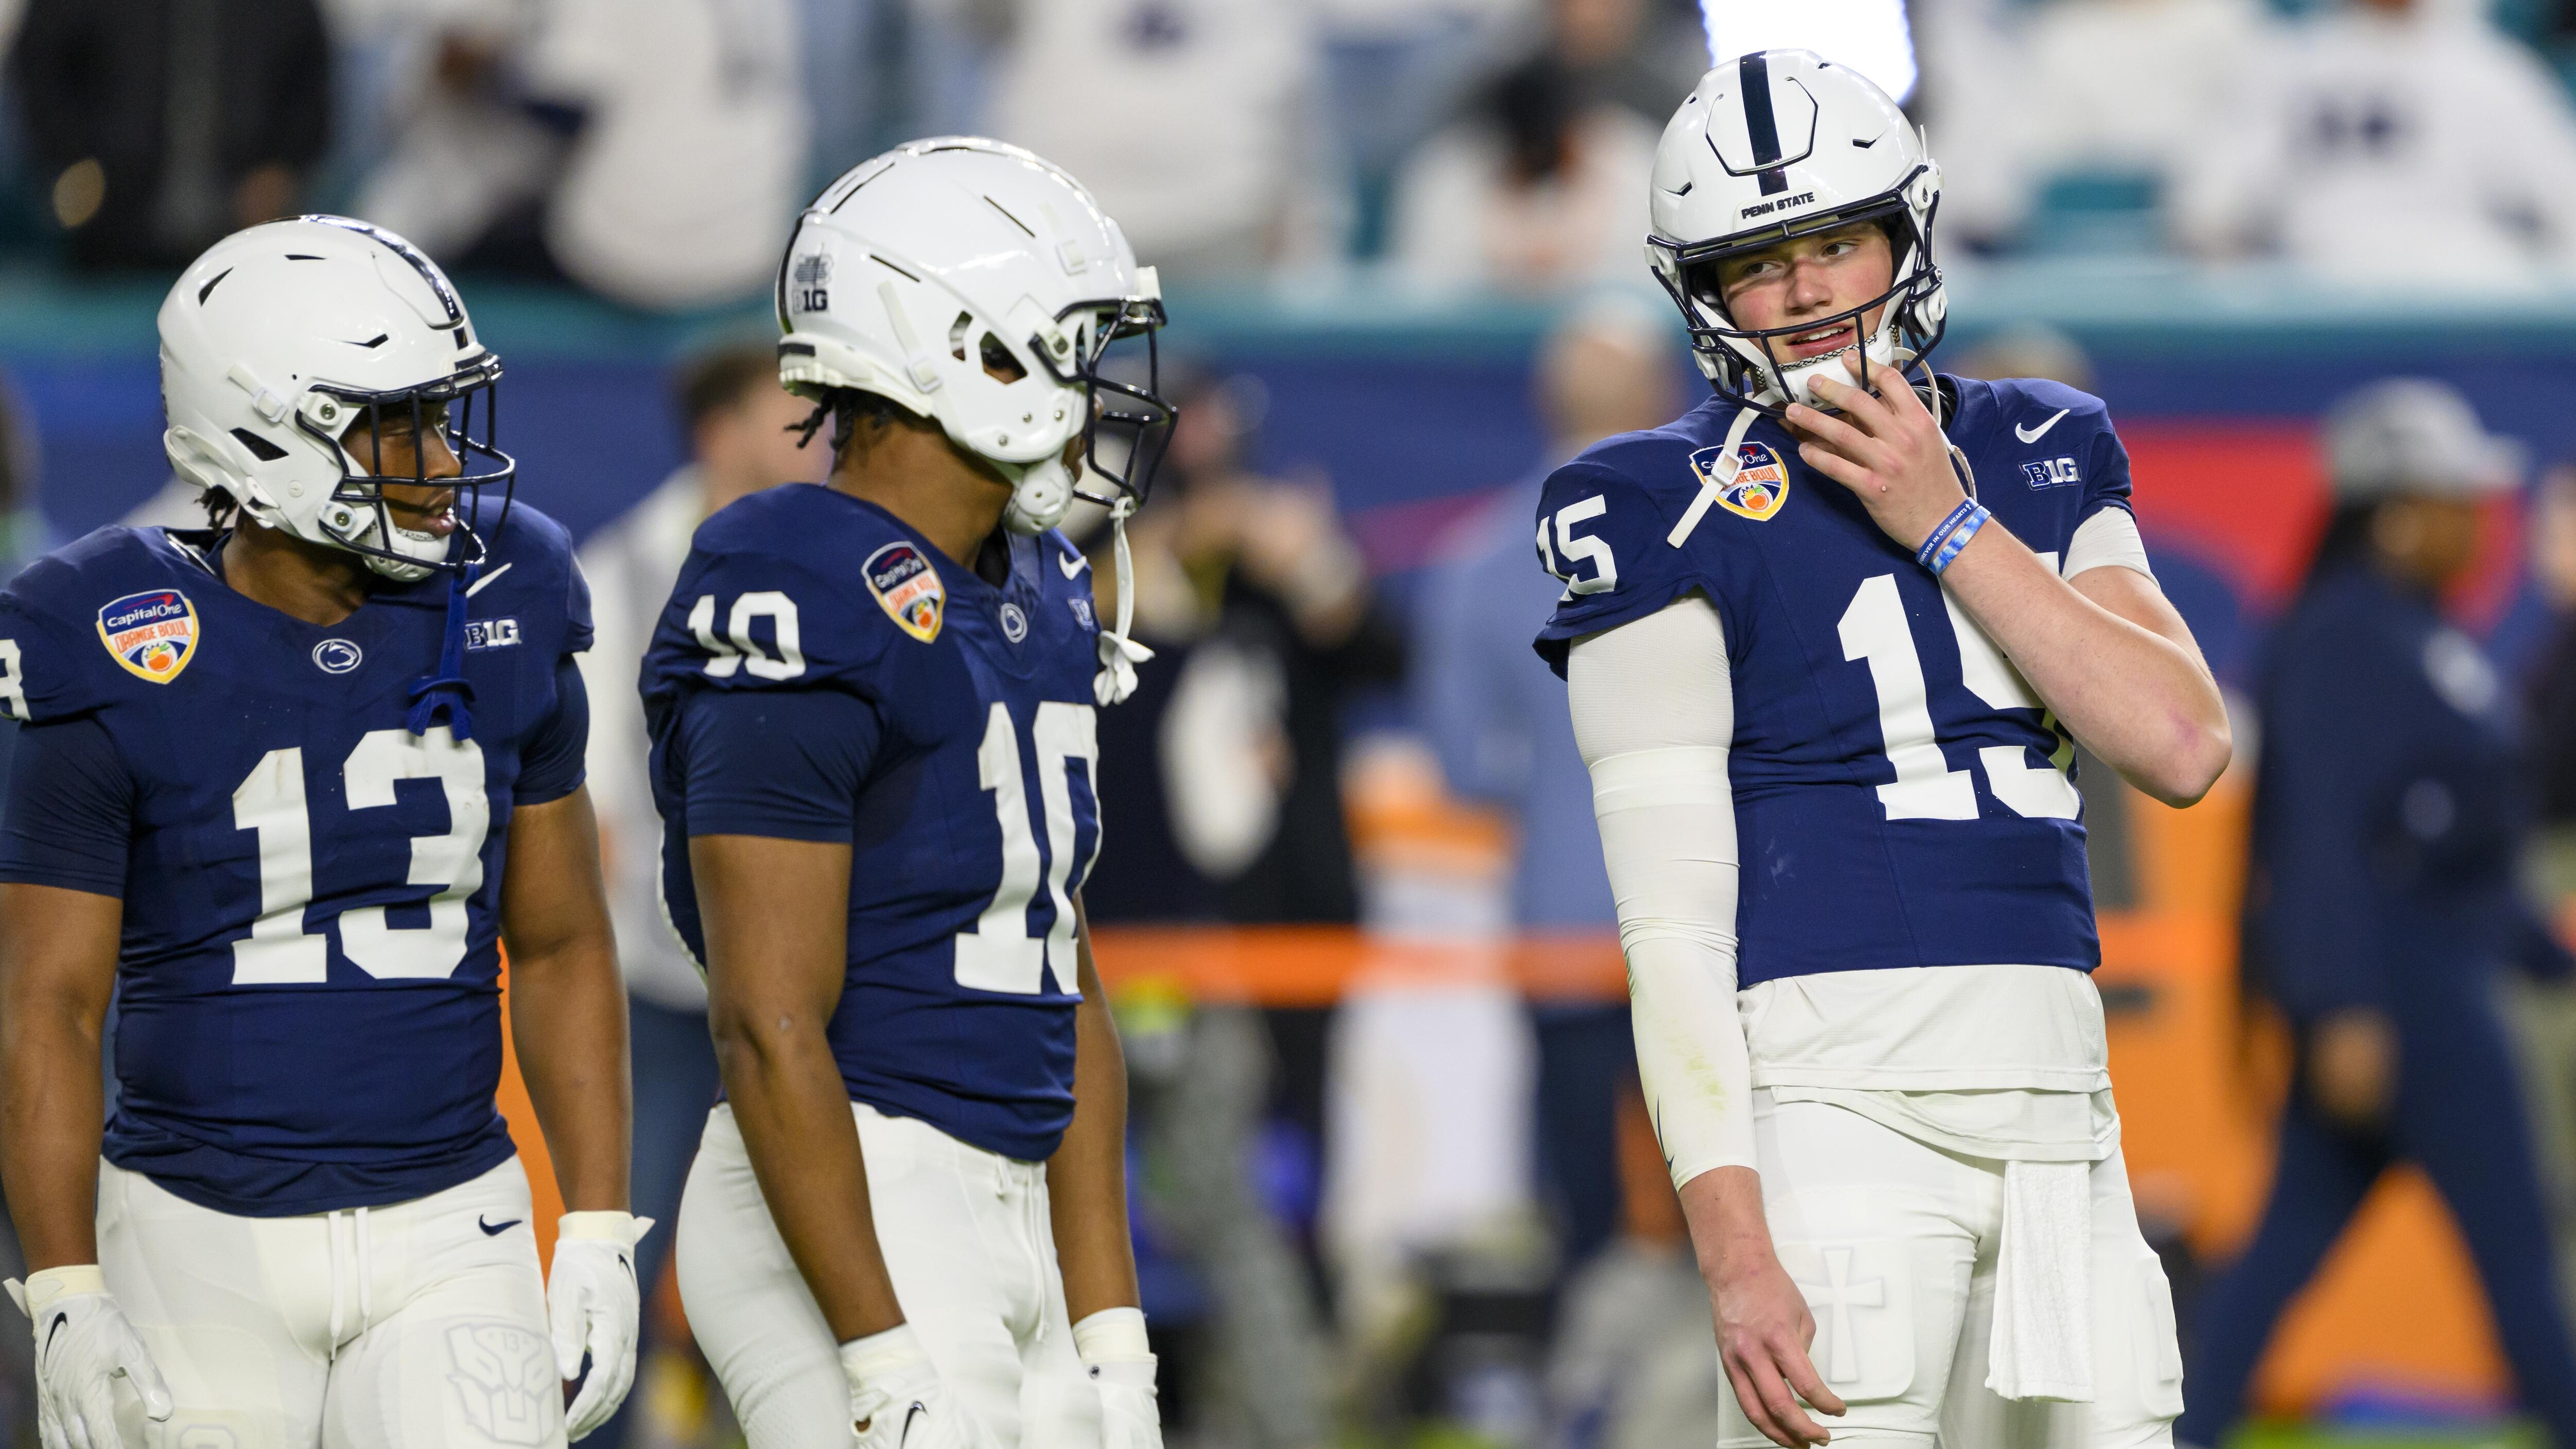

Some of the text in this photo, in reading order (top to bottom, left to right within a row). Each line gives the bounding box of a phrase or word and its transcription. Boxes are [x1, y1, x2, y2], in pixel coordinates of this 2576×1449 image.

[1741, 192, 1815, 220] PENN STATE
[1748, 466, 1783, 481] BOWL
[1537, 494, 1618, 601] 15
[1919, 508, 1968, 564] FOREVER IN OUR HEARTS
[114, 620, 192, 654] ORANGE BOWL
[688, 591, 805, 681] 10
[232, 726, 490, 985] 13
[954, 701, 1103, 995] 10
